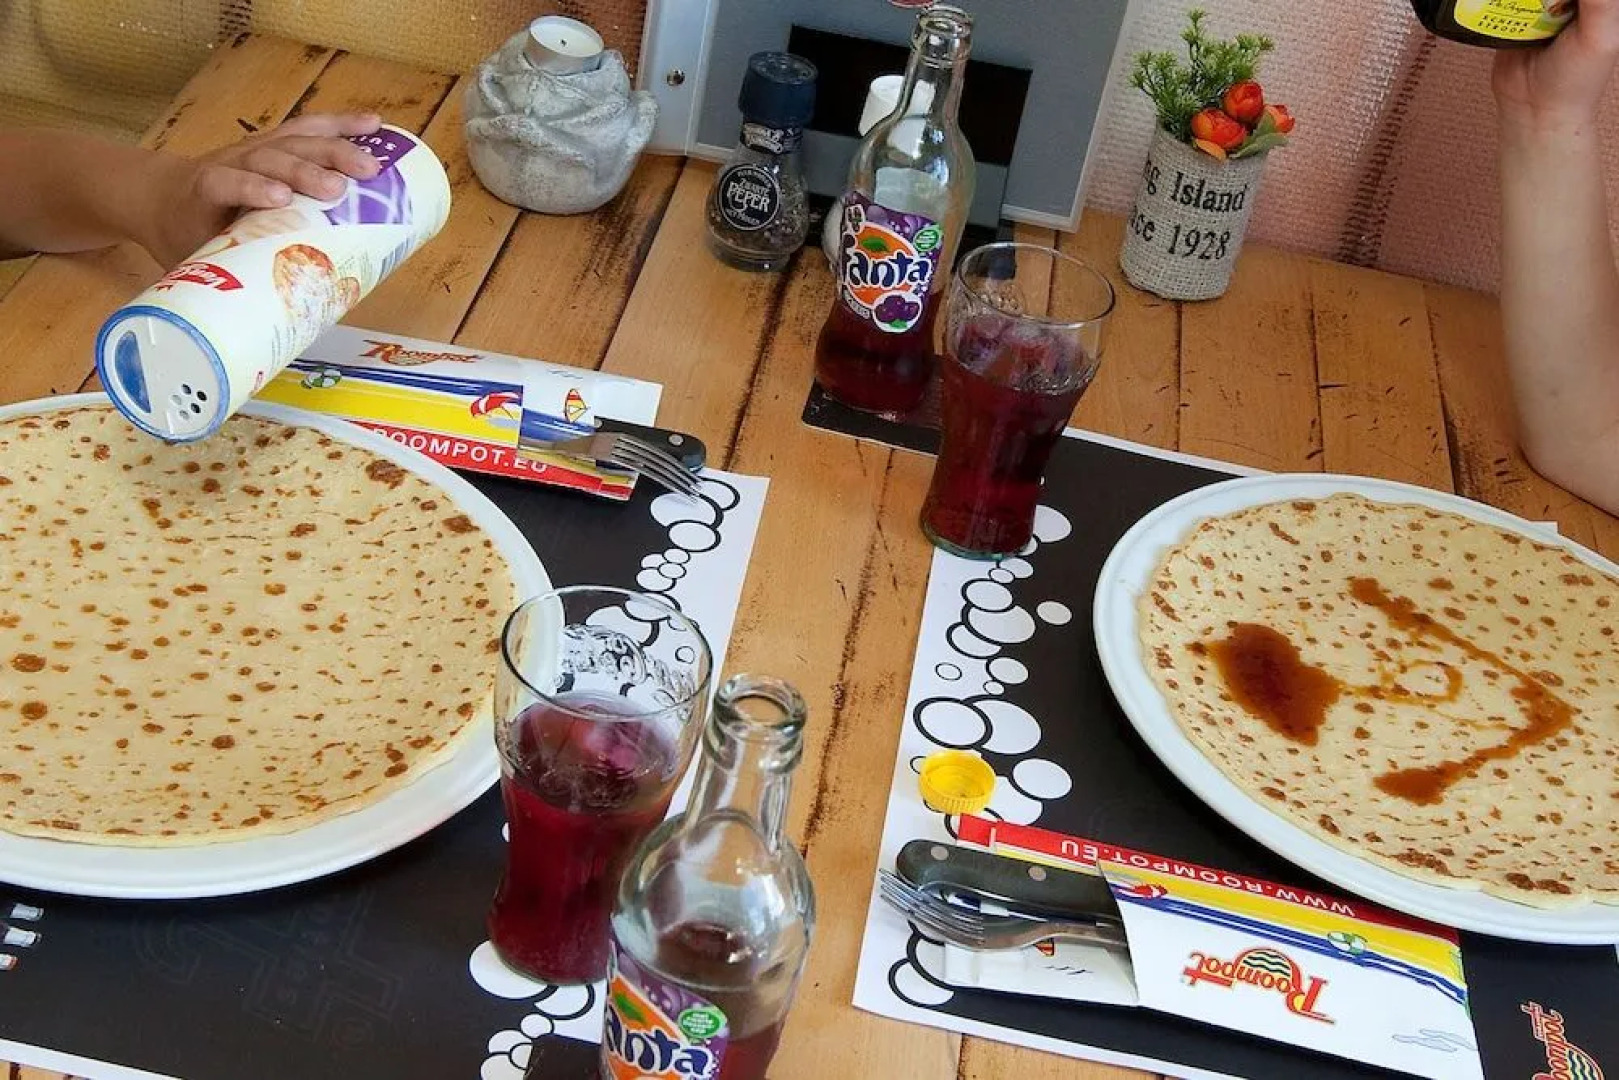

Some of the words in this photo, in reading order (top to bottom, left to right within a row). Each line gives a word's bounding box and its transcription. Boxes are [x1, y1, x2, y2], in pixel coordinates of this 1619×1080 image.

[727, 181, 770, 213] PEPER
[1170, 171, 1247, 212] Island
[1168, 222, 1231, 261] 1928
[1181, 947, 1338, 1026] Roompot
[606, 1004, 710, 1076] anta
